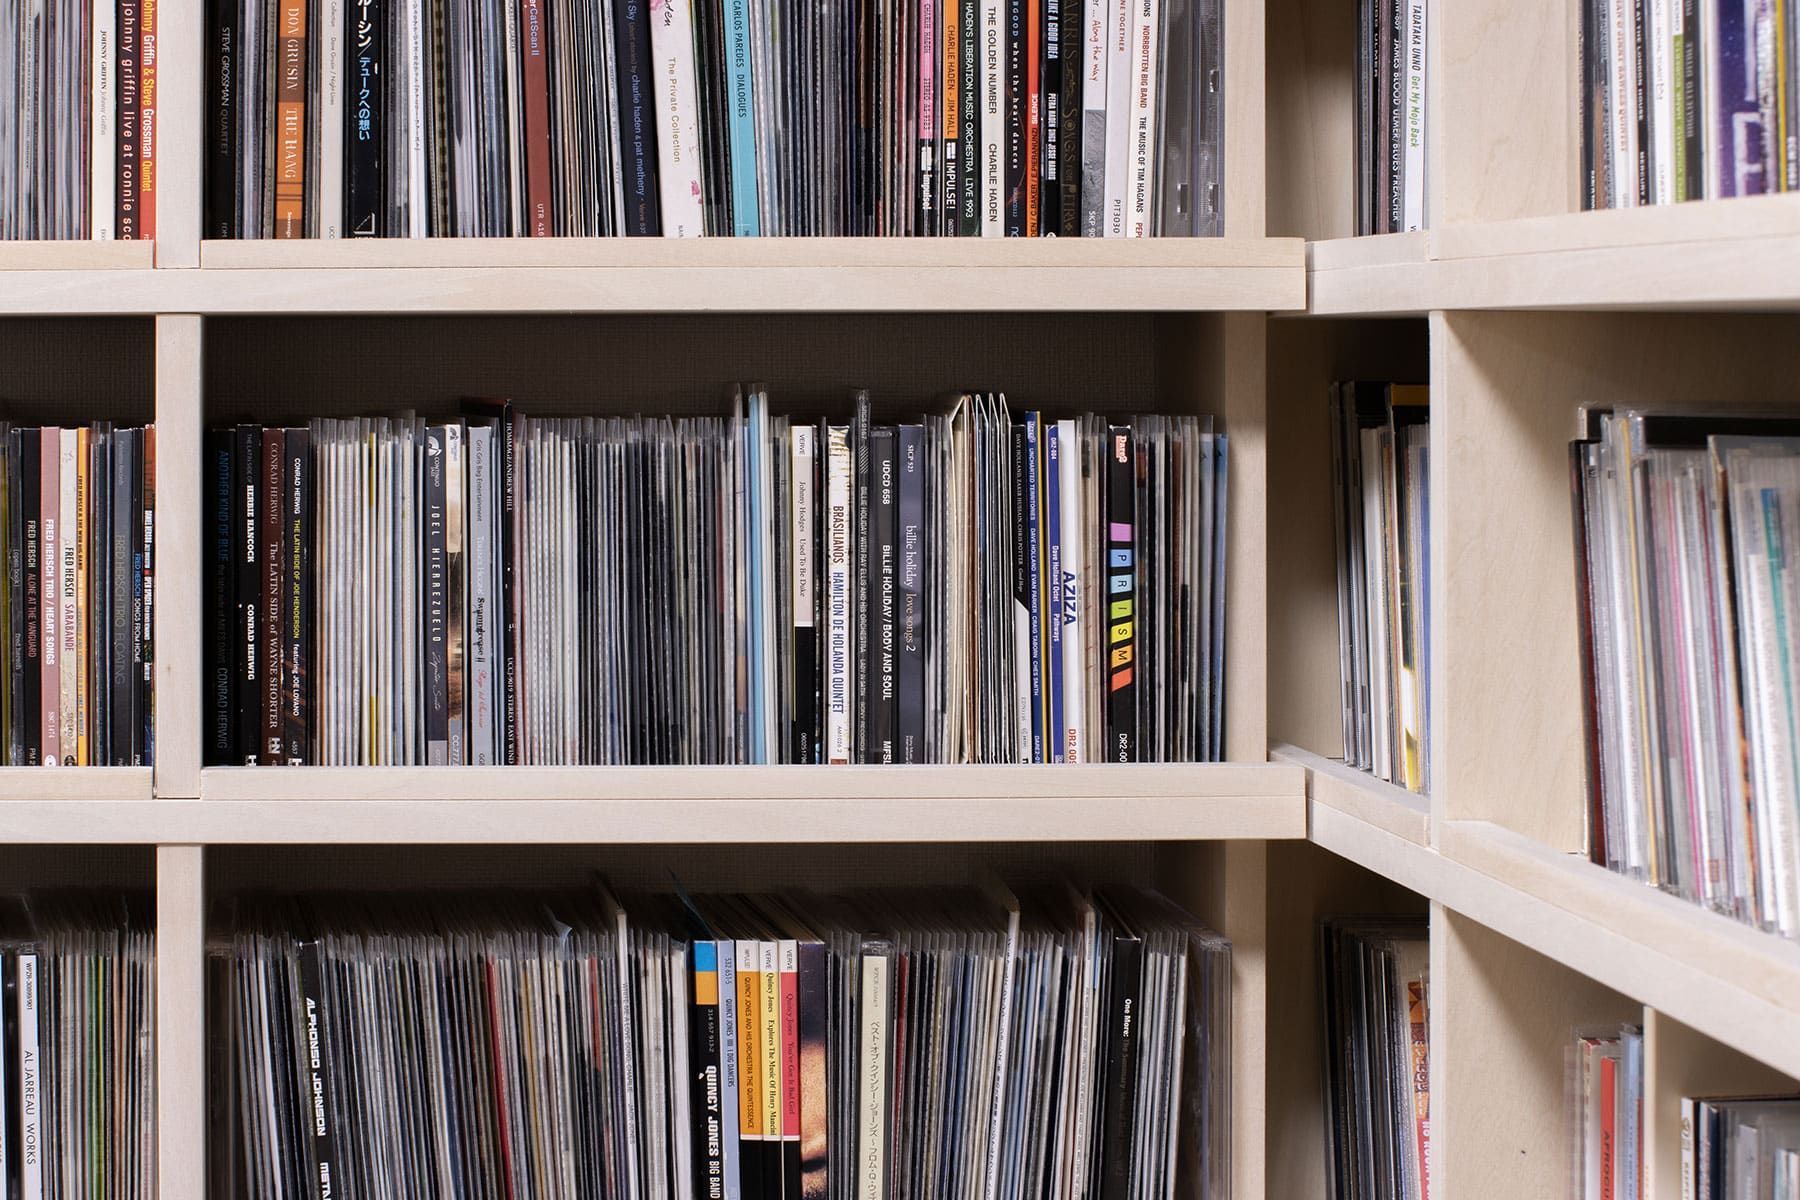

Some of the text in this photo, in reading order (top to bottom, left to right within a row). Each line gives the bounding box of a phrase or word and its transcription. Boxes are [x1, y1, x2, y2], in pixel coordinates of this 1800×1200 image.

[122, 2, 136, 52] johnny
[222, 26, 231, 53] STEVE
[1048, 22, 1058, 42] GOOD
[100, 31, 108, 59] JOHNNY
[144, 35, 155, 66] Griffin
[733, 0, 748, 118] CARLOS PAREDES DIALOGUES
[1048, 43, 1058, 59] IDEA
[1090, 20, 1102, 82] Along the way
[100, 61, 108, 90] GRIFFIN
[122, 59, 135, 104] griffin
[144, 68, 154, 76] &
[221, 56, 231, 107] GROSSMAN
[1410, 4, 1423, 149] TADATAKA UNNO Get My Mojo Back
[144, 78, 155, 106] Steve
[285, 8, 300, 179] DON GRUSIN THE HANG
[1012, 42, 1020, 170] when the heart dances
[124, 111, 135, 137] live
[668, 57, 682, 163] The Private Collection
[947, 25, 957, 210] CHARLIE HADEN JIM HALL IMPULSE!
[966, 2, 974, 219] HADEN'S LIBERATION MUSIC ORCHESTRA LIVE 1993
[988, 6, 998, 222] THE GOLDEN NUMBER CHARLIE HADEN
[1113, 12, 1127, 234] TOGETHER PIT3030
[1136, 25, 1151, 214] NORRBOTTEN BIG BAND THE MUSIC OF TIM HAGANS
[143, 108, 155, 158] Grossman
[124, 144, 135, 158] at
[124, 164, 135, 211] ronnie
[142, 160, 154, 192] Quintet
[882, 460, 892, 487] UDCD
[246, 484, 255, 518] HERBIE
[798, 481, 807, 505] Johnny
[882, 488, 892, 505] 658
[293, 519, 301, 533] THE
[432, 504, 441, 536] JOEL
[798, 506, 807, 533] Hodges
[246, 519, 255, 563] HANCOCK
[293, 534, 301, 553] LATIN
[906, 525, 918, 550] billie
[293, 554, 301, 570] SIDE
[800, 558, 807, 567] To
[883, 544, 892, 574] BILLIE
[905, 552, 918, 588] holiday
[269, 442, 279, 729] CONRAD HERWIG The LATIN SIDE of WAYNE SHORTER
[292, 582, 300, 595] JOE
[293, 570, 301, 581] OF
[64, 548, 75, 652] FRED HERSCH SARABANDE
[432, 547, 441, 642] HIERREZUELO
[883, 576, 892, 616] HOLIDAY
[906, 593, 918, 614] love
[247, 604, 255, 642] CONRAD
[292, 596, 300, 639] HENDERSON
[832, 506, 845, 715] BRASILIANOS HAMILTON DE HOLANDA QUINTET
[883, 624, 892, 650] BODY
[904, 616, 914, 644] songs
[291, 644, 300, 674] featuring
[906, 644, 917, 652] 2
[1064, 571, 1078, 747] AZIZA DR2
[247, 644, 255, 681] HERWIG
[883, 652, 892, 673] AND
[292, 675, 300, 688] JOE
[883, 674, 892, 701] SOUL
[292, 689, 300, 717] LOVANO
[766, 972, 775, 994] Quincy
[768, 995, 776, 1013] Jones
[1124, 998, 1133, 1014] One
[766, 1019, 776, 1047] Explores
[1122, 1015, 1132, 1038] More:
[306, 996, 327, 1137] ALPHONSO JOHNSON
[768, 1048, 776, 1059] The
[768, 1060, 776, 1079] Music
[704, 1064, 718, 1113] QUINCY
[769, 1080, 777, 1089] Of
[25, 1050, 36, 1166] AL JARREAU WORKS
[768, 1090, 777, 1110] Henry
[708, 1115, 720, 1157] JONES
[770, 1110, 778, 1136] Mancini
[709, 1160, 721, 1175] BIG
[710, 1176, 721, 1199] BAND
